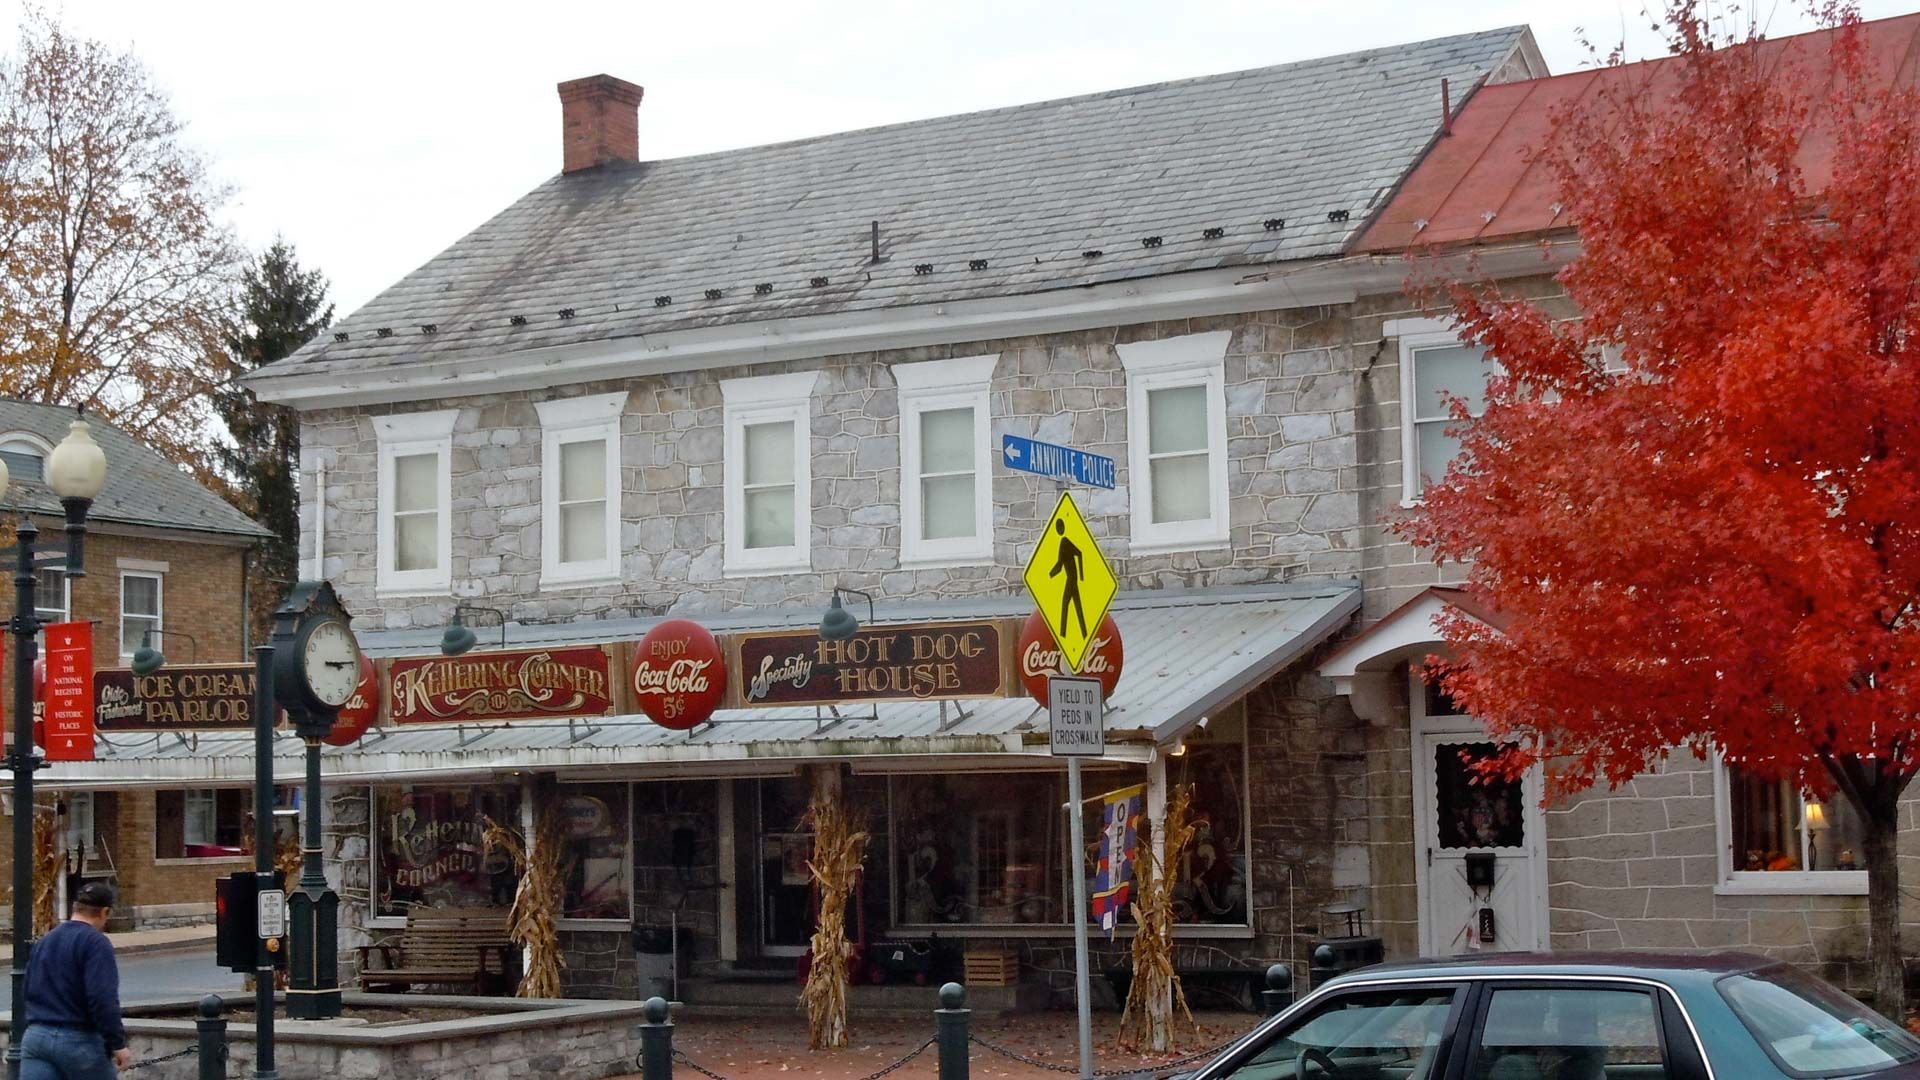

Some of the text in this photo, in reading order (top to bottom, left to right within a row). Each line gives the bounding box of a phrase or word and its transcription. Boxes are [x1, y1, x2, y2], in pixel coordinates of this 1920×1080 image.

[1030, 443, 1115, 487] ANNVILLE POLICE
[63, 654, 73, 662] ON
[651, 638, 690, 660] ENJOY
[814, 632, 984, 664] HOT DOG
[132, 676, 175, 699] ICE
[394, 652, 607, 717] KETTERING CORNER
[634, 658, 713, 694] Coca-Cola
[748, 653, 812, 700] Specialty
[836, 662, 960, 698] HOUSE
[55, 688, 82, 696] REGISTER
[102, 684, 128, 704] Olde
[1058, 689, 1093, 704] YIELD TO
[96, 701, 144, 724] Fashioned
[146, 700, 250, 722] PARLOR
[663, 695, 685, 718] 5¢
[1062, 710, 1092, 724] PEDS IN
[59, 722, 80, 730] PLACES
[1055, 730, 1100, 744] CROSSWALK
[1114, 802, 1126, 885] OPEN
